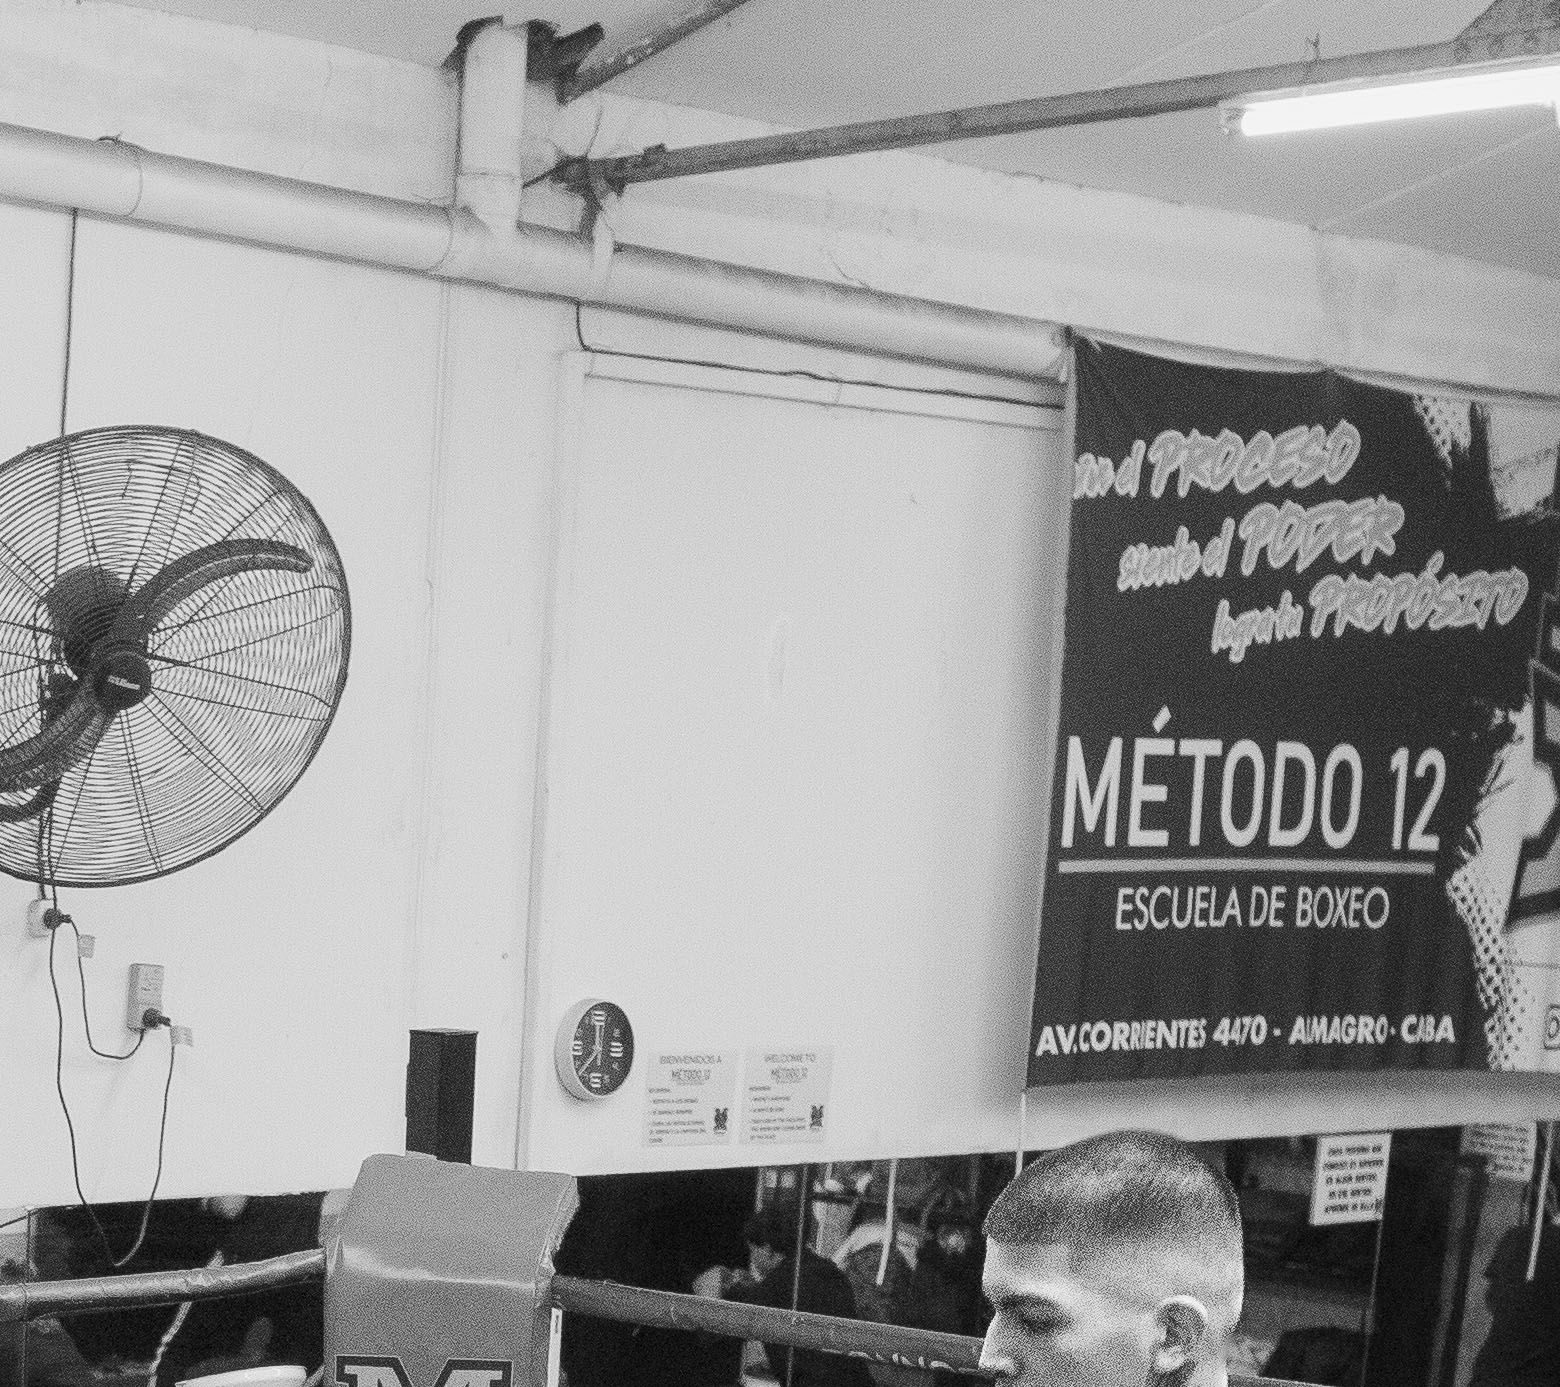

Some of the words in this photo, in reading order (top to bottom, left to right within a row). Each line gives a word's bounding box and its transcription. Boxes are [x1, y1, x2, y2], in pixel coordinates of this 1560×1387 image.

[1148, 418, 1362, 500] PROCESO
[1238, 494, 1406, 577] PODER
[1308, 550, 1530, 640] PROPÓSITO
[1061, 704, 1364, 850] MÉTODO
[1390, 746, 1447, 851] 12
[1115, 885, 1242, 931] ESCUELA
[1248, 885, 1288, 929] DE
[1295, 885, 1391, 930] BOXEO
[1211, 1015, 1269, 1047] 4470
